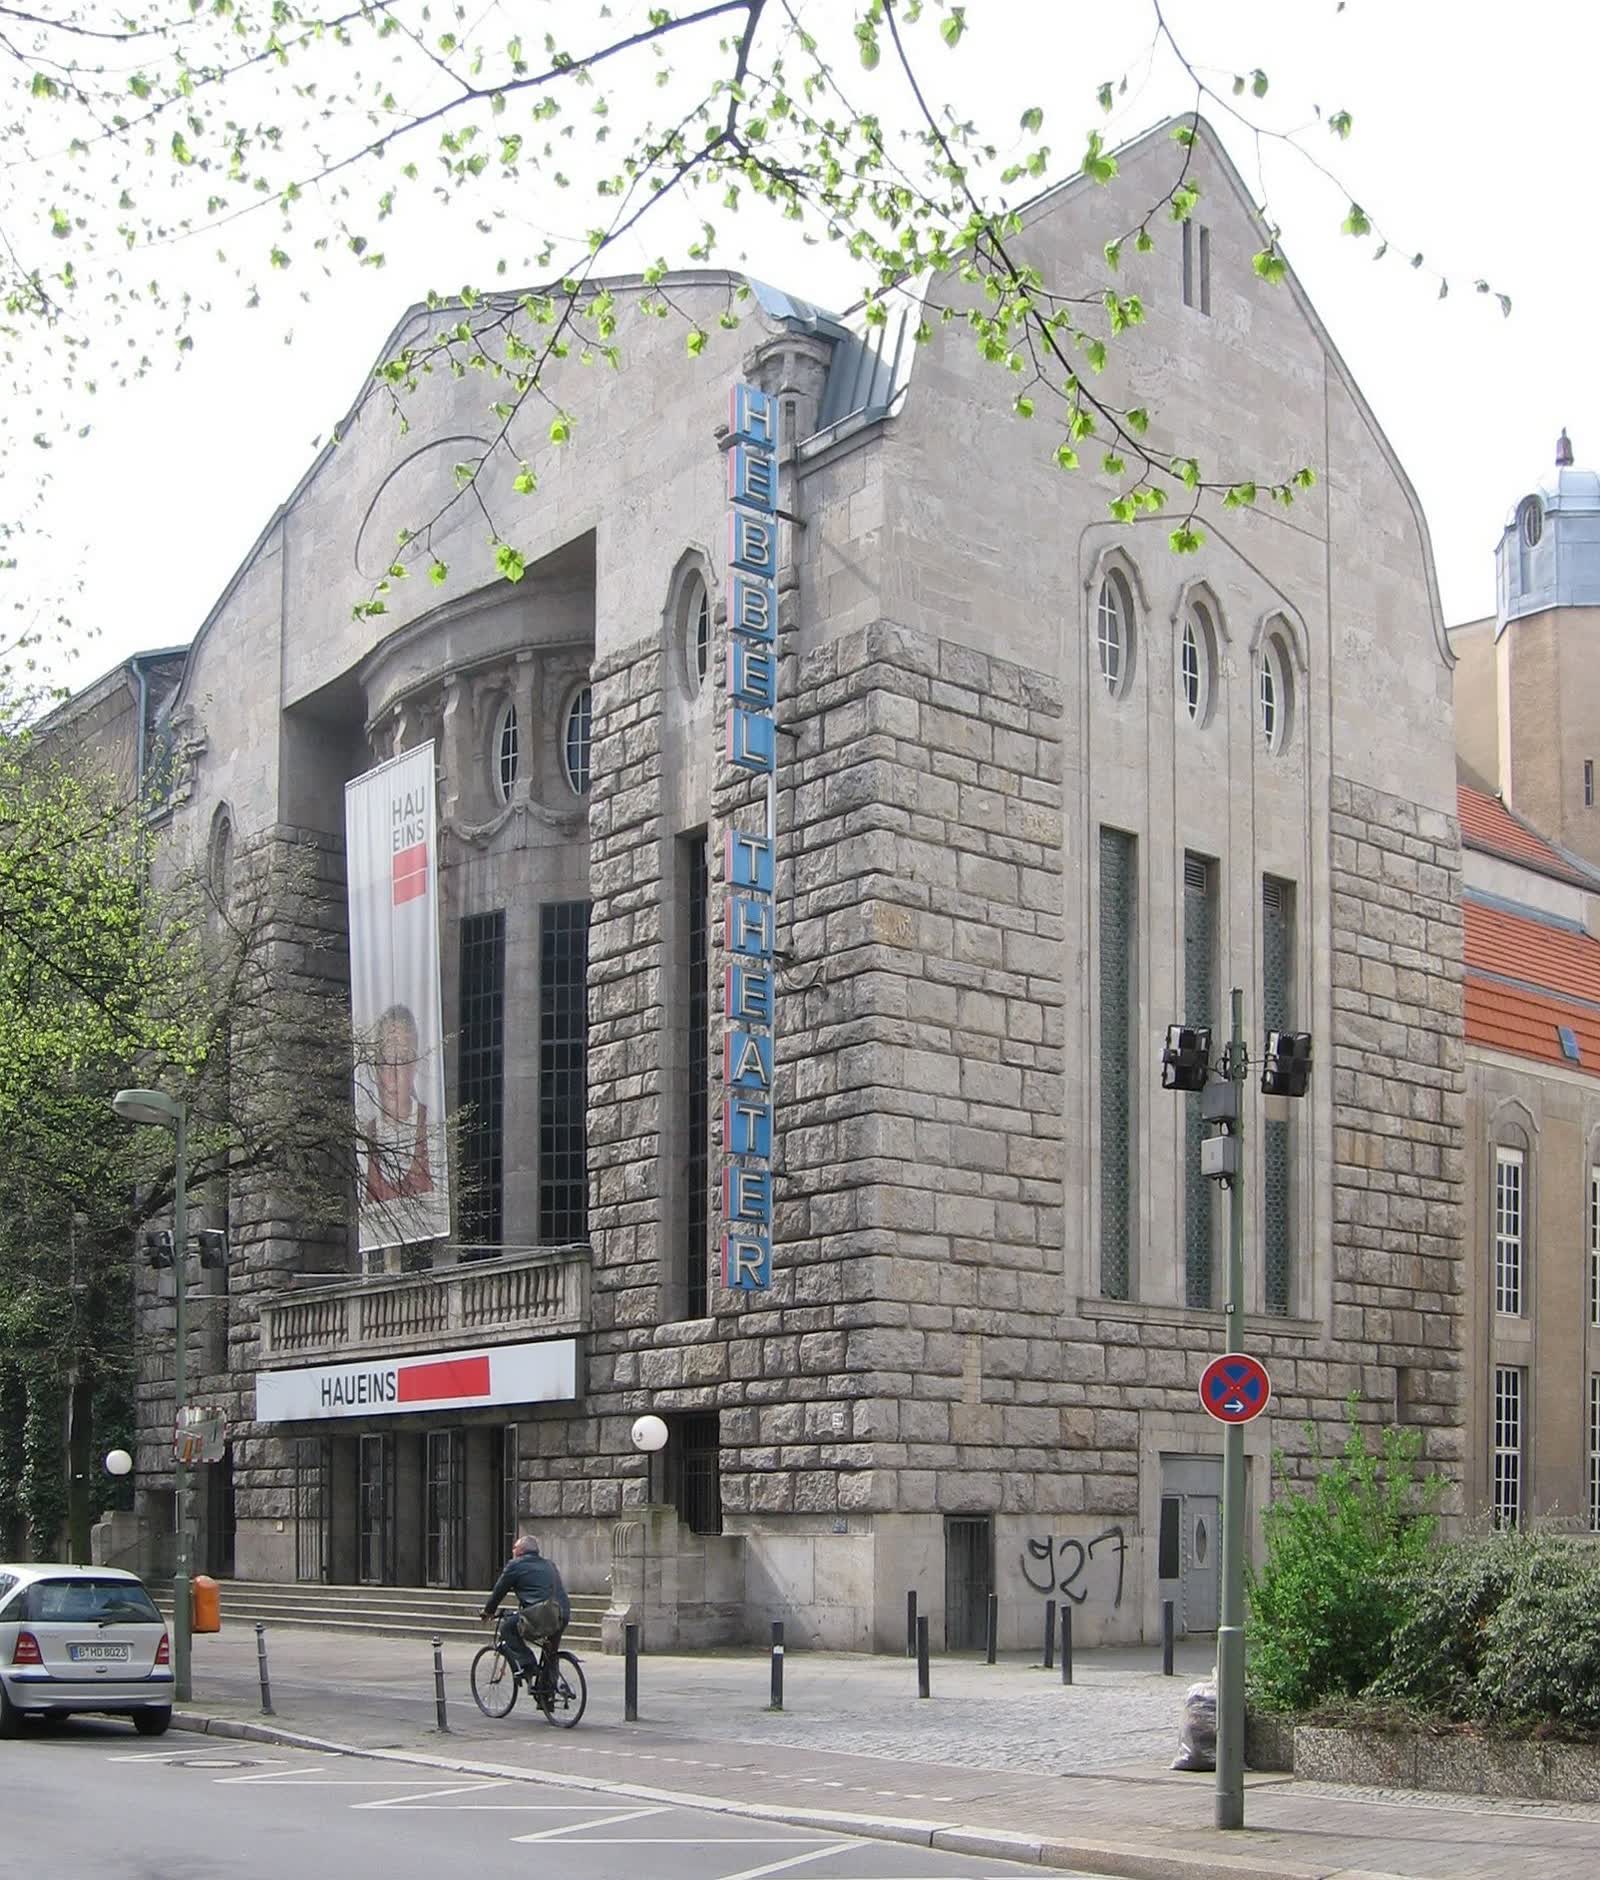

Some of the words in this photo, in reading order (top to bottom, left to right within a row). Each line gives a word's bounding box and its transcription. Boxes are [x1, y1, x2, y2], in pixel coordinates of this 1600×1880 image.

[741, 389, 773, 764] HEBBEL
[392, 785, 425, 826] HAU
[392, 818, 425, 852] EINS
[734, 835, 769, 1287] THEATER
[321, 1371, 396, 1407] HAUEINS
